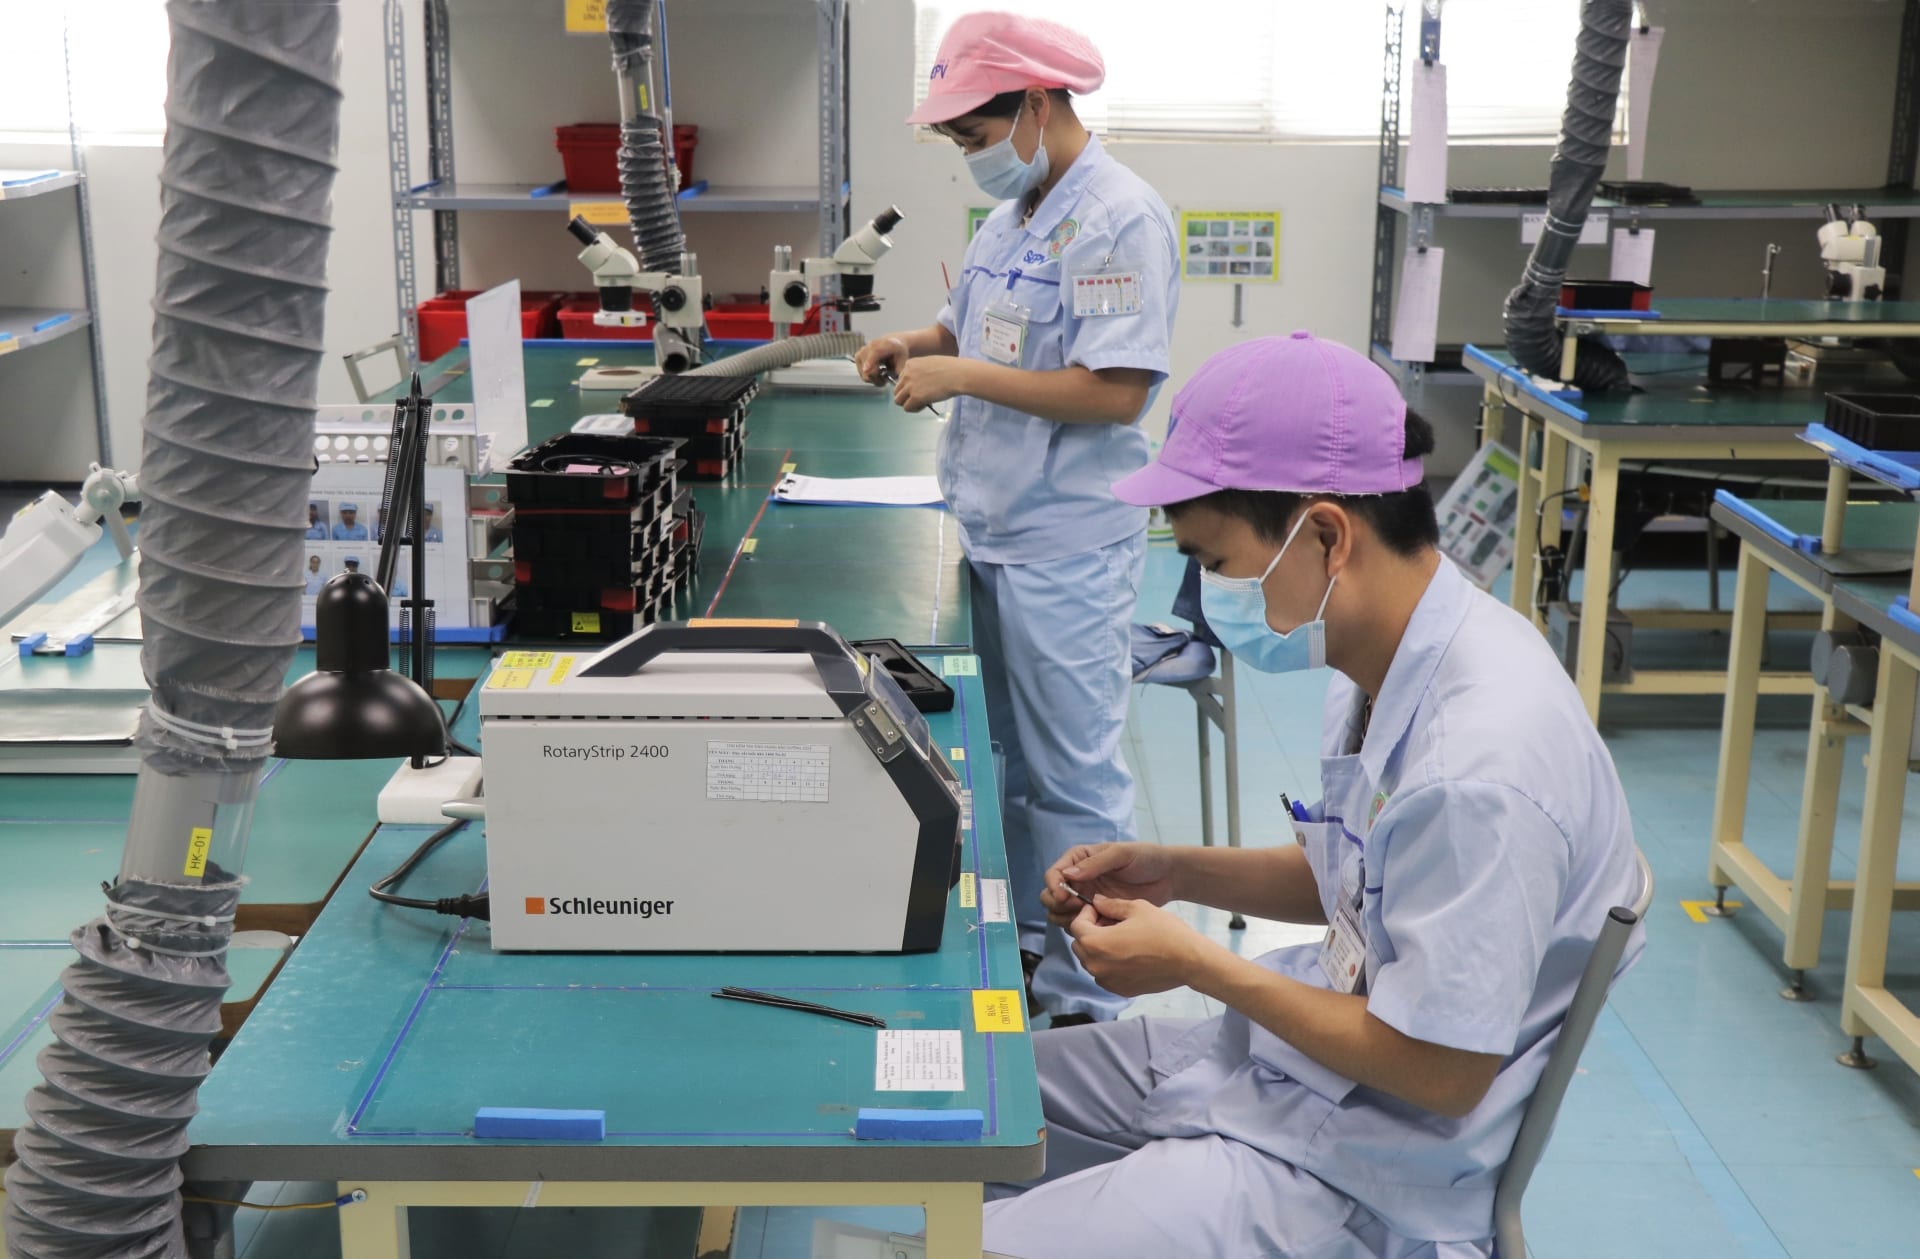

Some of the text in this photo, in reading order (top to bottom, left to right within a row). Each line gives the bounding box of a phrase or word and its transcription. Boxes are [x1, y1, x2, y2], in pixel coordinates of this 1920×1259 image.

[543, 745, 669, 760] RotaryStrip 2400
[191, 835, 208, 869] HK-01
[550, 897, 674, 919] Schleuniger
